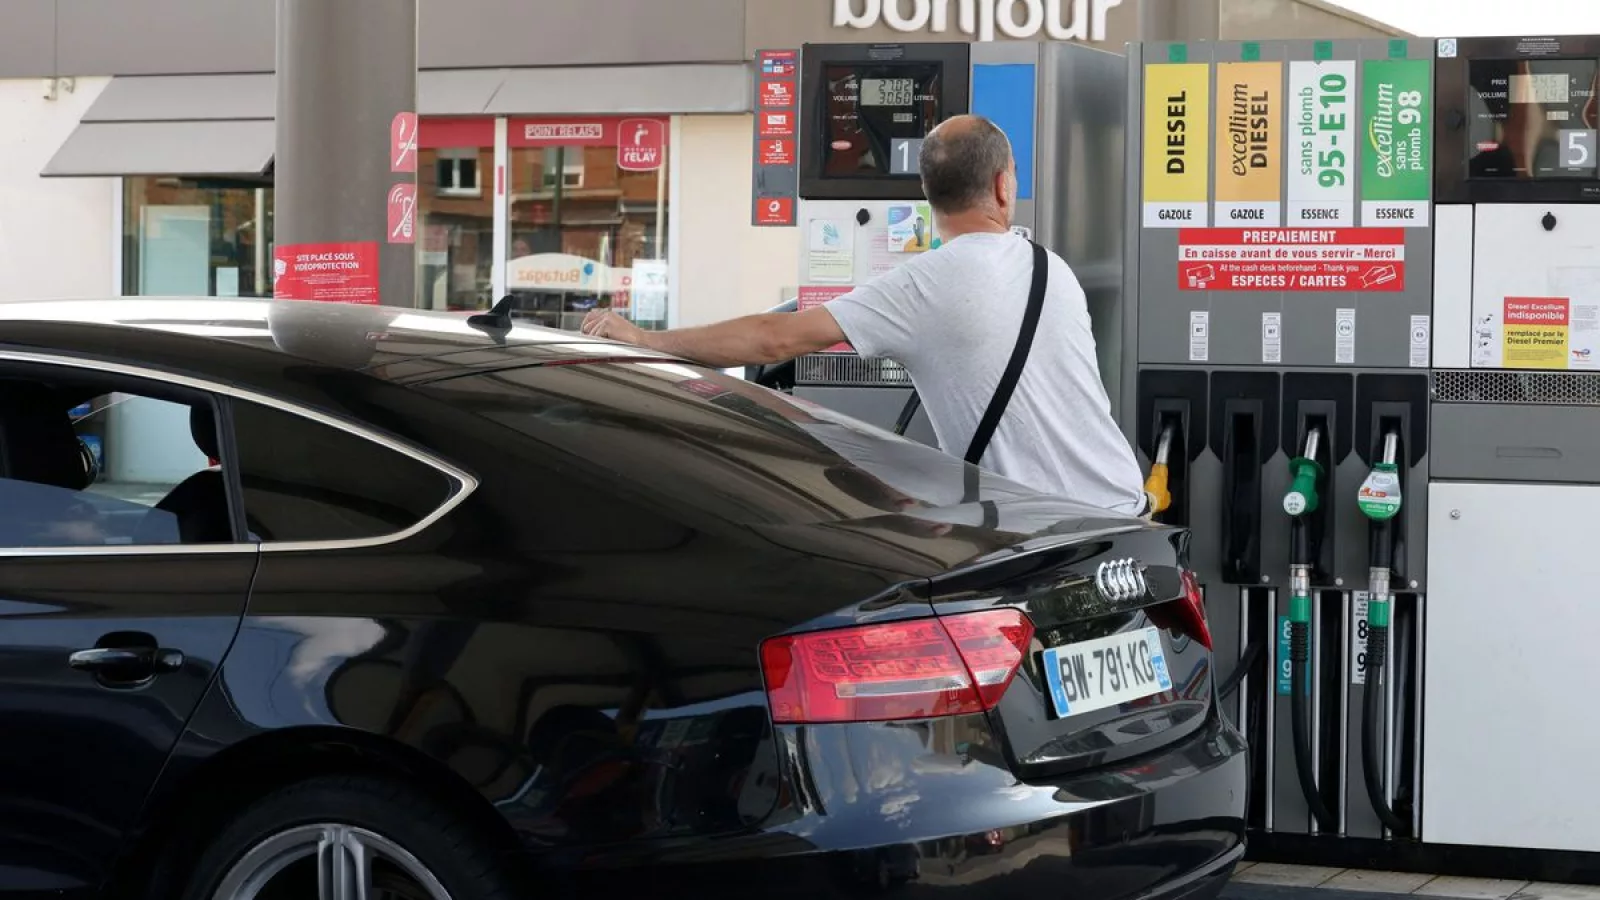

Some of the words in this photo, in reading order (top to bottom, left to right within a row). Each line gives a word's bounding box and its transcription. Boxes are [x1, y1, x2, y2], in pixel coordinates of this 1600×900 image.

[833, 0, 1121, 41] bonjour
[1297, 86, 1317, 136] plomb
[1397, 90, 1422, 125] 98
[528, 126, 556, 136] POINT
[1167, 90, 1186, 174] DIESEL
[1229, 83, 1249, 177] excellium
[1250, 90, 1269, 169] DIESEL
[1317, 73, 1347, 188] 95-E10
[1374, 83, 1393, 178] excellium
[897, 140, 909, 172] 1
[1301, 141, 1313, 175] sans
[1396, 140, 1407, 170] sans
[1407, 127, 1424, 171] plomb
[1567, 131, 1589, 166] 5
[1158, 208, 1192, 220] GAZOLE
[1230, 208, 1265, 220] GAZOLE
[1301, 208, 1339, 220] ESSENCE
[1375, 207, 1415, 219] ESSENCE
[1243, 230, 1337, 243] PREPAIEMENT
[296, 254, 310, 262] SITE
[335, 252, 356, 261] SOUS
[1184, 247, 1198, 258] En
[1202, 247, 1237, 258] caisse
[1240, 247, 1271, 258] avant
[1275, 247, 1288, 258] de
[1292, 249, 1318, 258] vous
[1322, 247, 1354, 258] servir
[1363, 247, 1396, 258] Merci
[1219, 263, 1228, 272] At
[1229, 263, 1240, 272] the
[1241, 263, 1258, 272] cash
[1260, 263, 1277, 272] desk
[1278, 263, 1317, 272] beforehand
[1323, 263, 1345, 272] Thank
[1346, 265, 1359, 273] you
[1231, 275, 1286, 287] ESPECES
[1289, 275, 1296, 287] /
[1299, 275, 1346, 287] CARTES
[1507, 310, 1565, 320] indisponible
[1532, 337, 1565, 345] Premier
